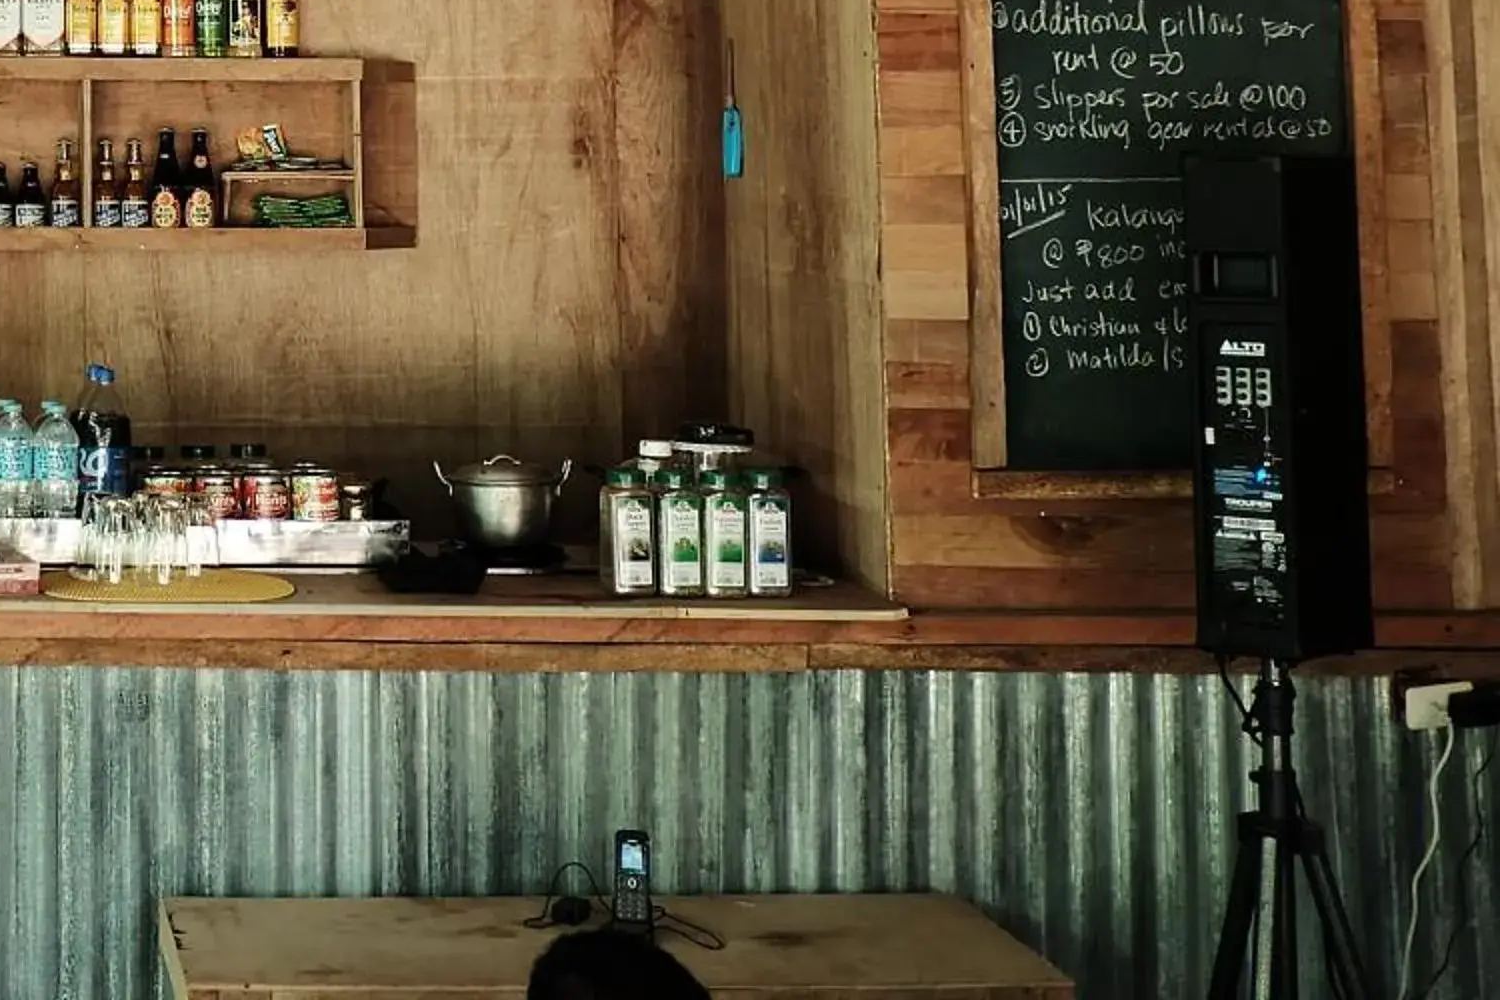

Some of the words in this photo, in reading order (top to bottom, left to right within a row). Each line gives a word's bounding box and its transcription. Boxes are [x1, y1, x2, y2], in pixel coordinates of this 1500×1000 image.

[1011, 0, 1150, 36] additional
[1160, 3, 1245, 53] pillows
[1052, 43, 1100, 75] rent
[1110, 46, 1137, 79] @
[1149, 50, 1185, 76] 50
[1187, 81, 1232, 110] sale
[1148, 117, 1194, 151] gear
[1043, 238, 1065, 269] @
[1021, 276, 1076, 304] Just
[1084, 276, 1138, 302] add
[1049, 309, 1141, 338] Christian
[1066, 341, 1155, 371] Matilda
[1219, 338, 1266, 357] ALTO
